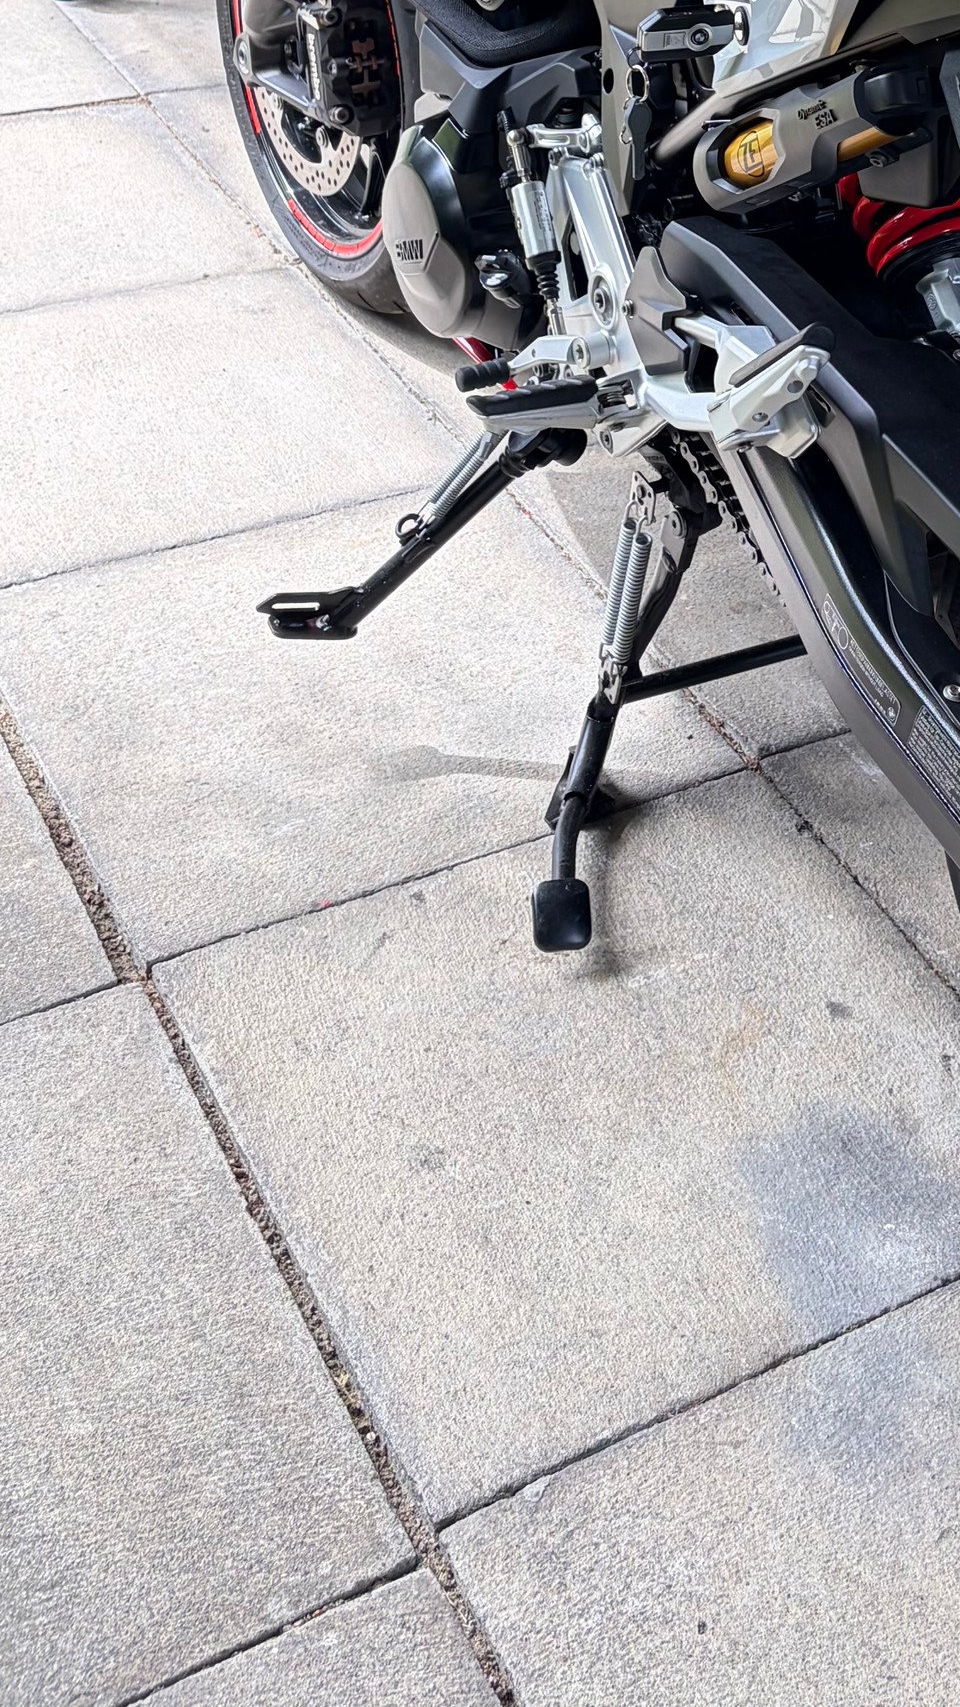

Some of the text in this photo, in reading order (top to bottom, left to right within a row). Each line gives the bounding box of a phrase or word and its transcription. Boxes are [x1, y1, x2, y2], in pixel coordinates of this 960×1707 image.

[307, 33, 320, 101] brembo
[814, 109, 838, 130] ESA
[739, 138, 764, 173] ZF
[395, 238, 424, 262] BMW
